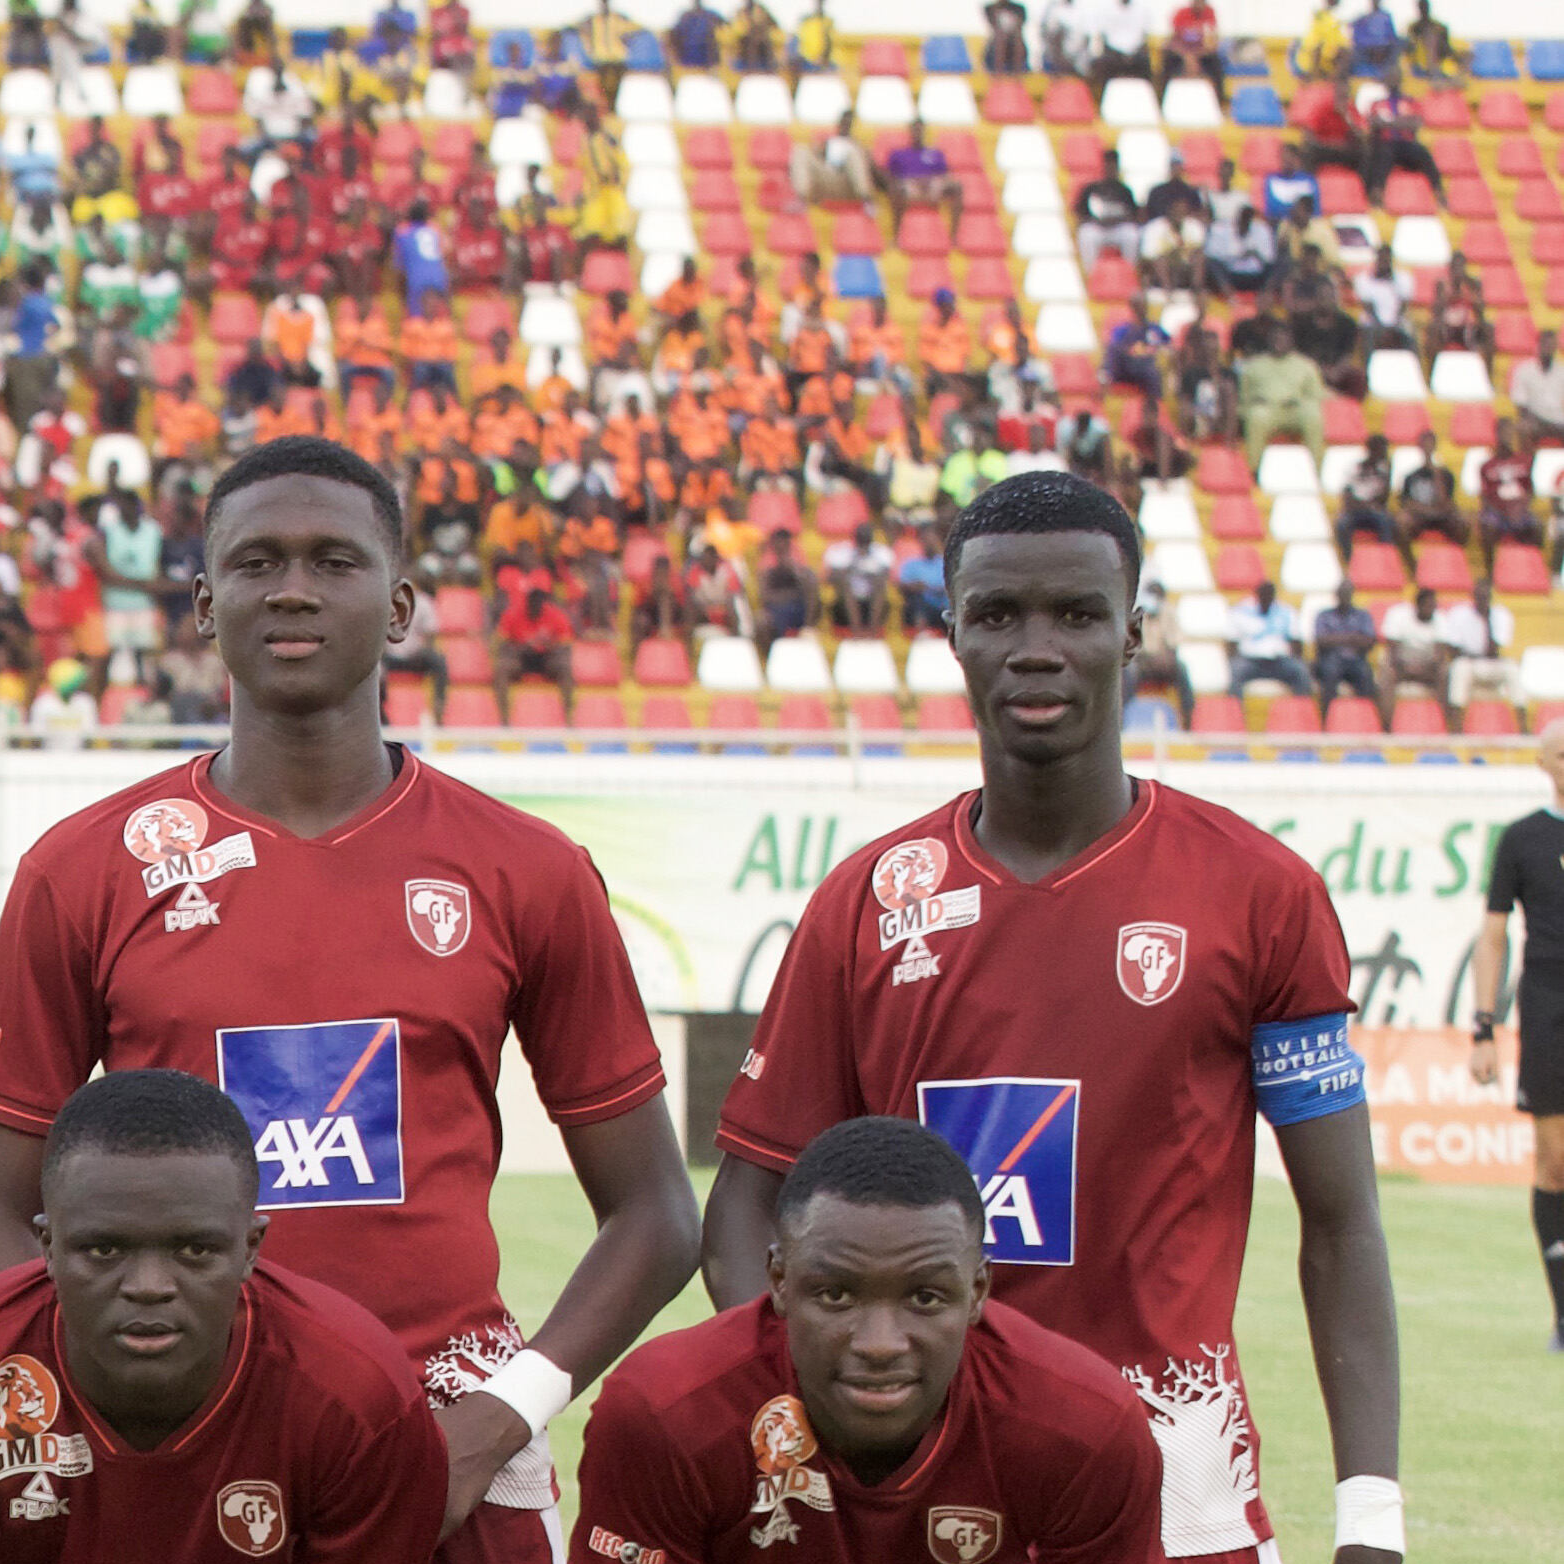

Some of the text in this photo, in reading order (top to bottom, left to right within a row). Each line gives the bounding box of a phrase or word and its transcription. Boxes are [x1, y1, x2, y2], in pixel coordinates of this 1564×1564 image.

[733, 813, 871, 891] All
[1321, 820, 1412, 896] du
[146, 850, 216, 890] GMD
[165, 902, 220, 932] PEAK
[429, 901, 453, 925] GF
[882, 897, 944, 942] GMD
[892, 954, 941, 987] PEAK
[1141, 945, 1165, 970] GF
[1319, 1067, 1360, 1095] FIFA
[256, 1115, 375, 1189] AXA
[972, 1175, 1044, 1247] XA
[9, 1496, 70, 1521] PEAK
[241, 1501, 268, 1524] GF
[953, 1527, 979, 1547] GF
